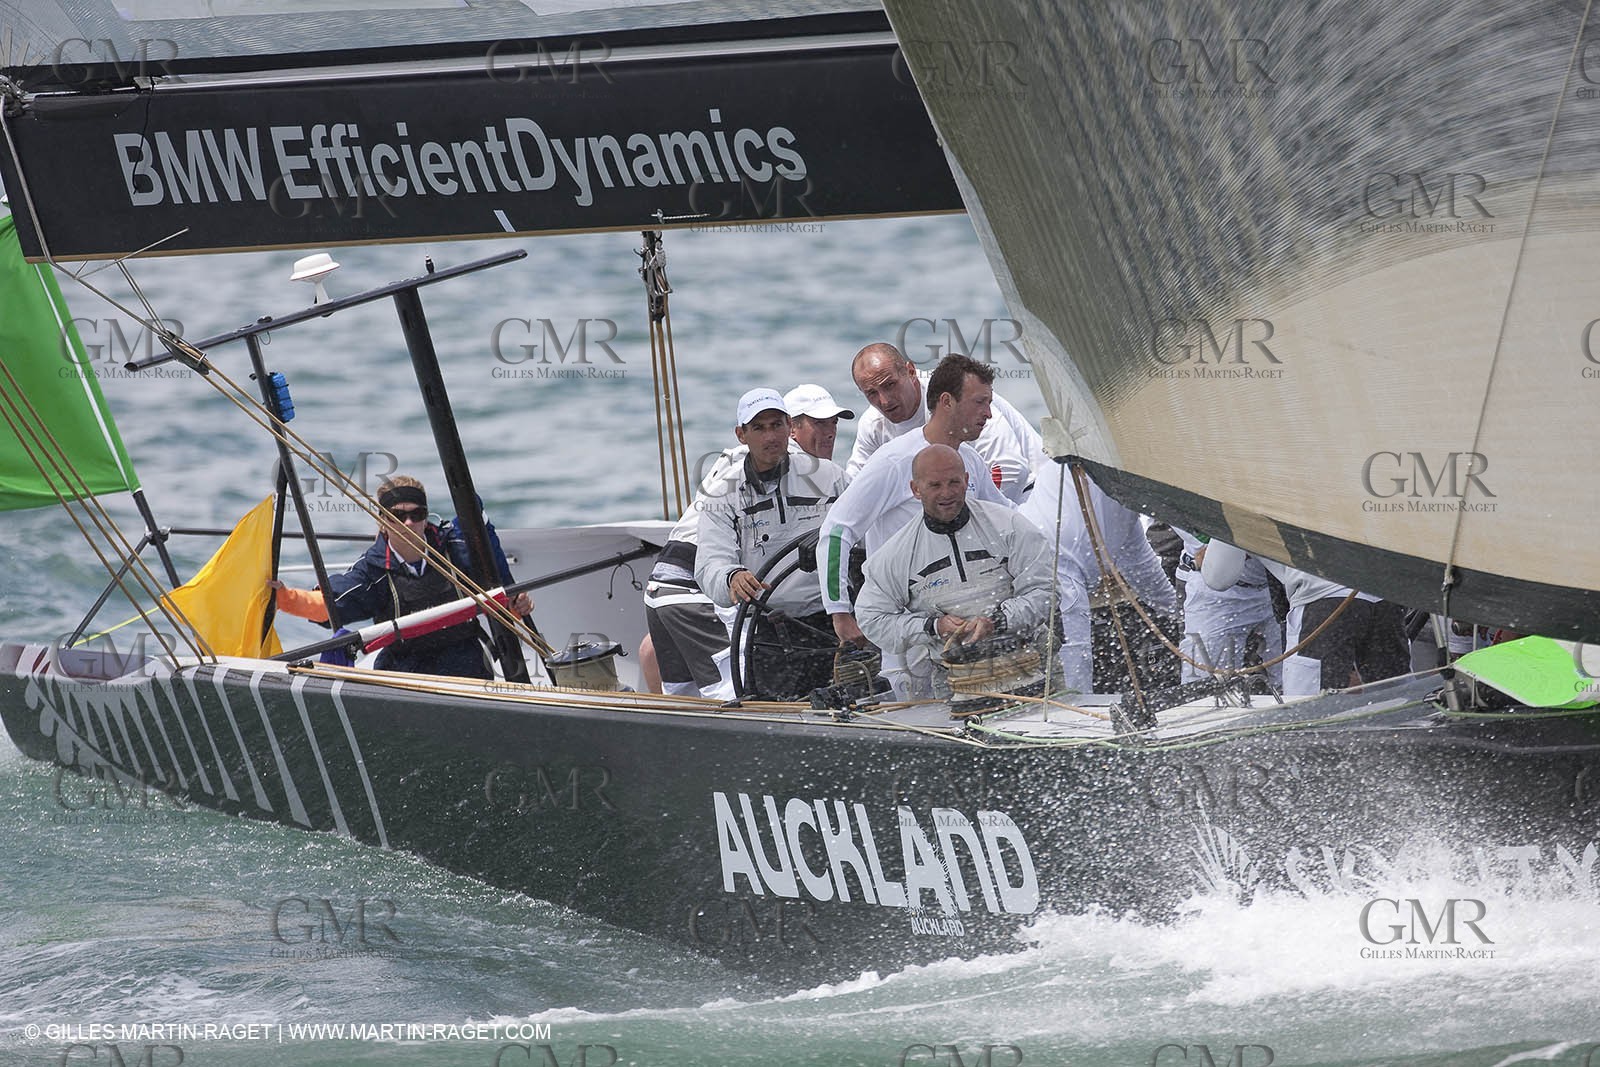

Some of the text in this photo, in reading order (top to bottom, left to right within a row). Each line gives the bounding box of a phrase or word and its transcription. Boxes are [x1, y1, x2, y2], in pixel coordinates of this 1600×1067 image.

[113, 108, 807, 207] BMW EfficientDynamics
[713, 791, 1041, 916] AUCKLAND
